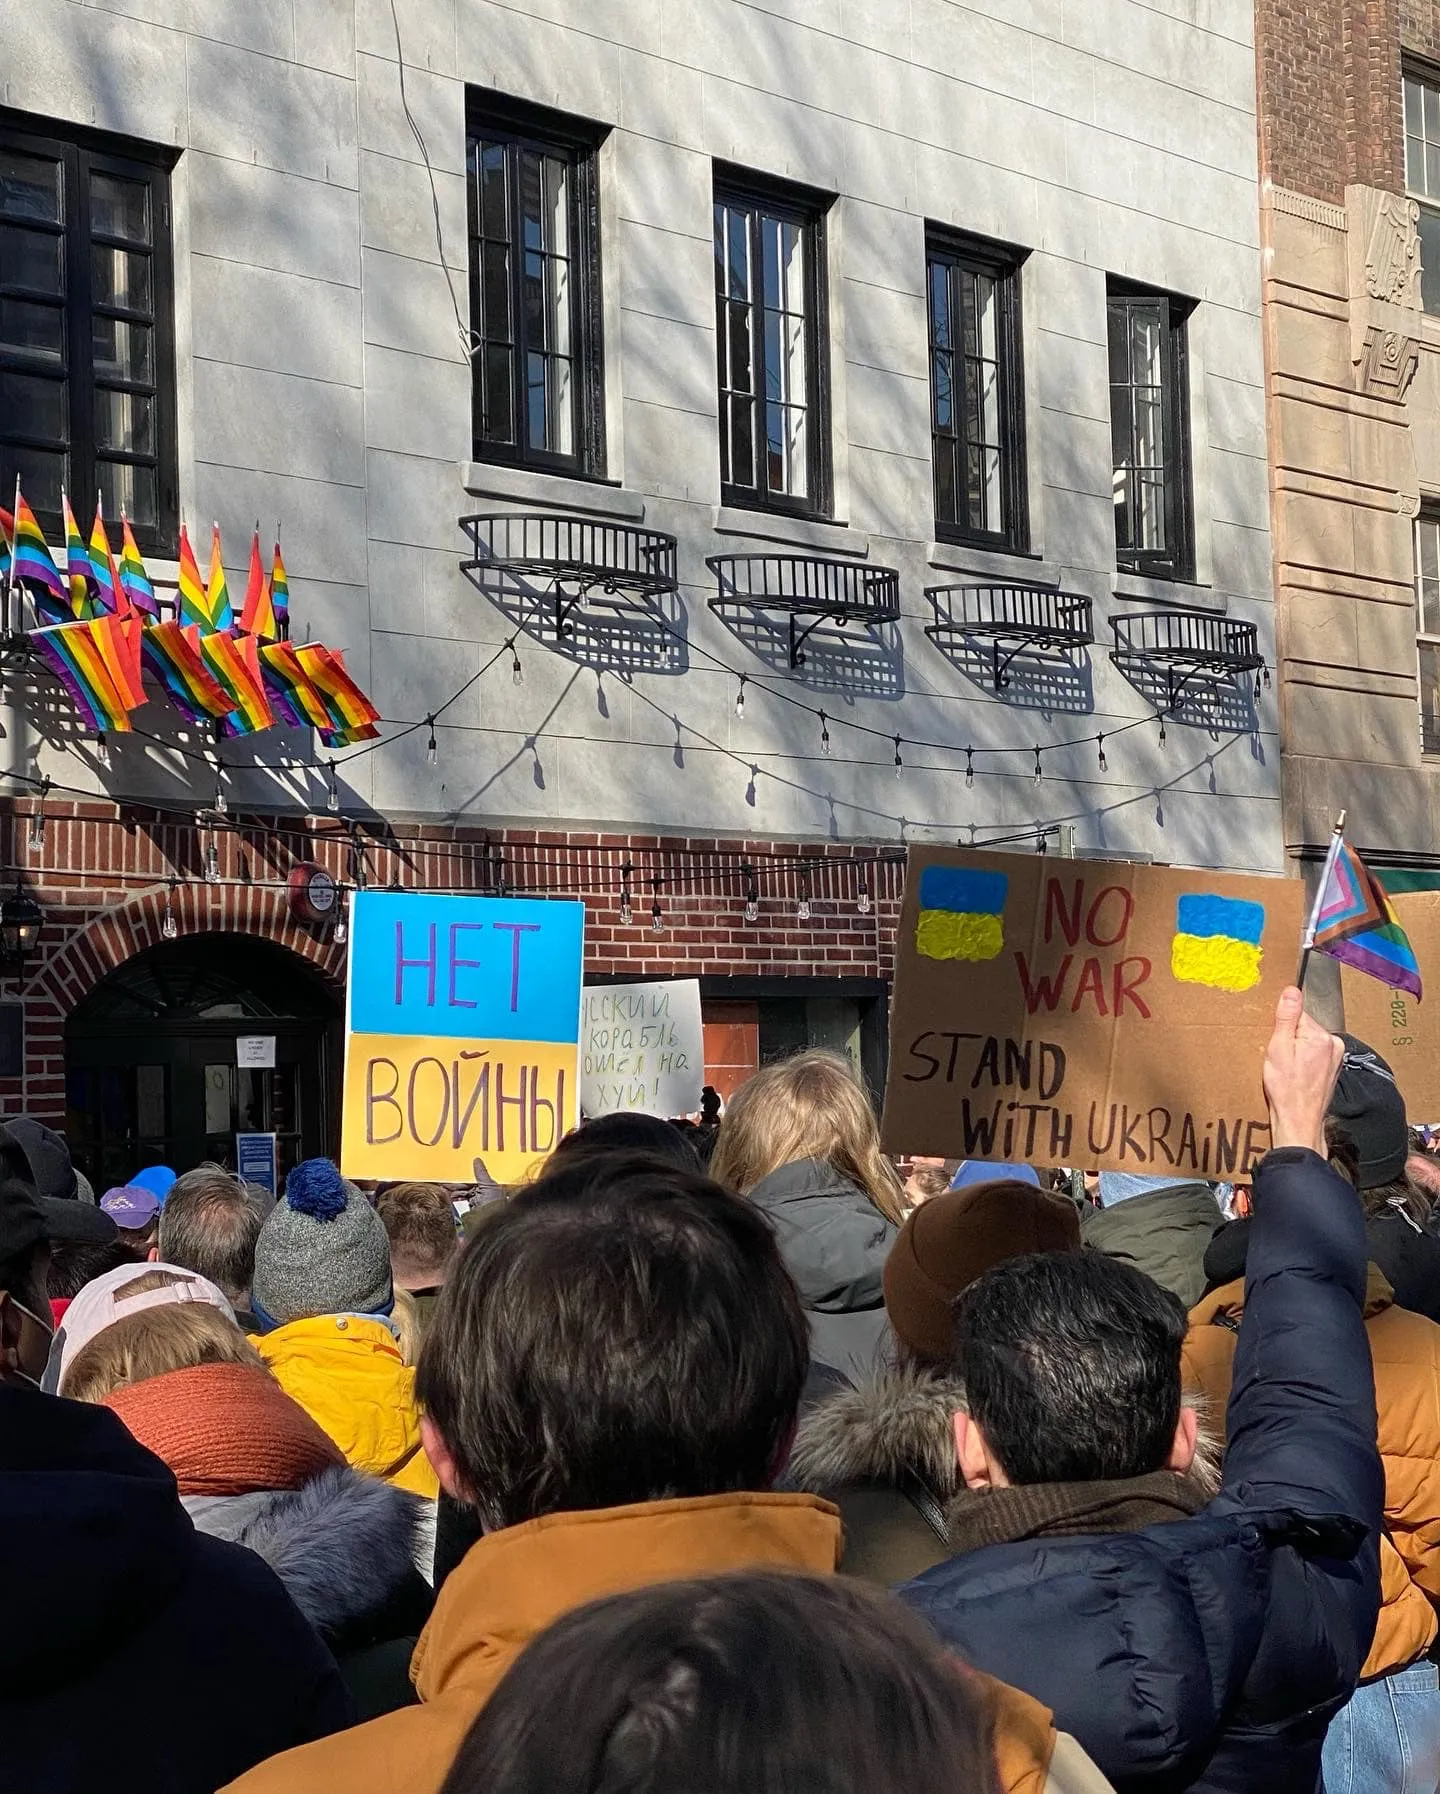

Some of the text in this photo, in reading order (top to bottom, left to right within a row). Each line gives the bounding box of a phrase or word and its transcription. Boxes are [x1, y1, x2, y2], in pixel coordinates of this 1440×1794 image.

[1044, 876, 1134, 947] NO
[395, 920, 542, 1012] НЕТ
[1014, 951, 1152, 1019] WAR
[1390, 985, 1408, 1028] 220-
[903, 1031, 1067, 1100] STAND
[366, 1050, 565, 1152] ВОЙНЫ
